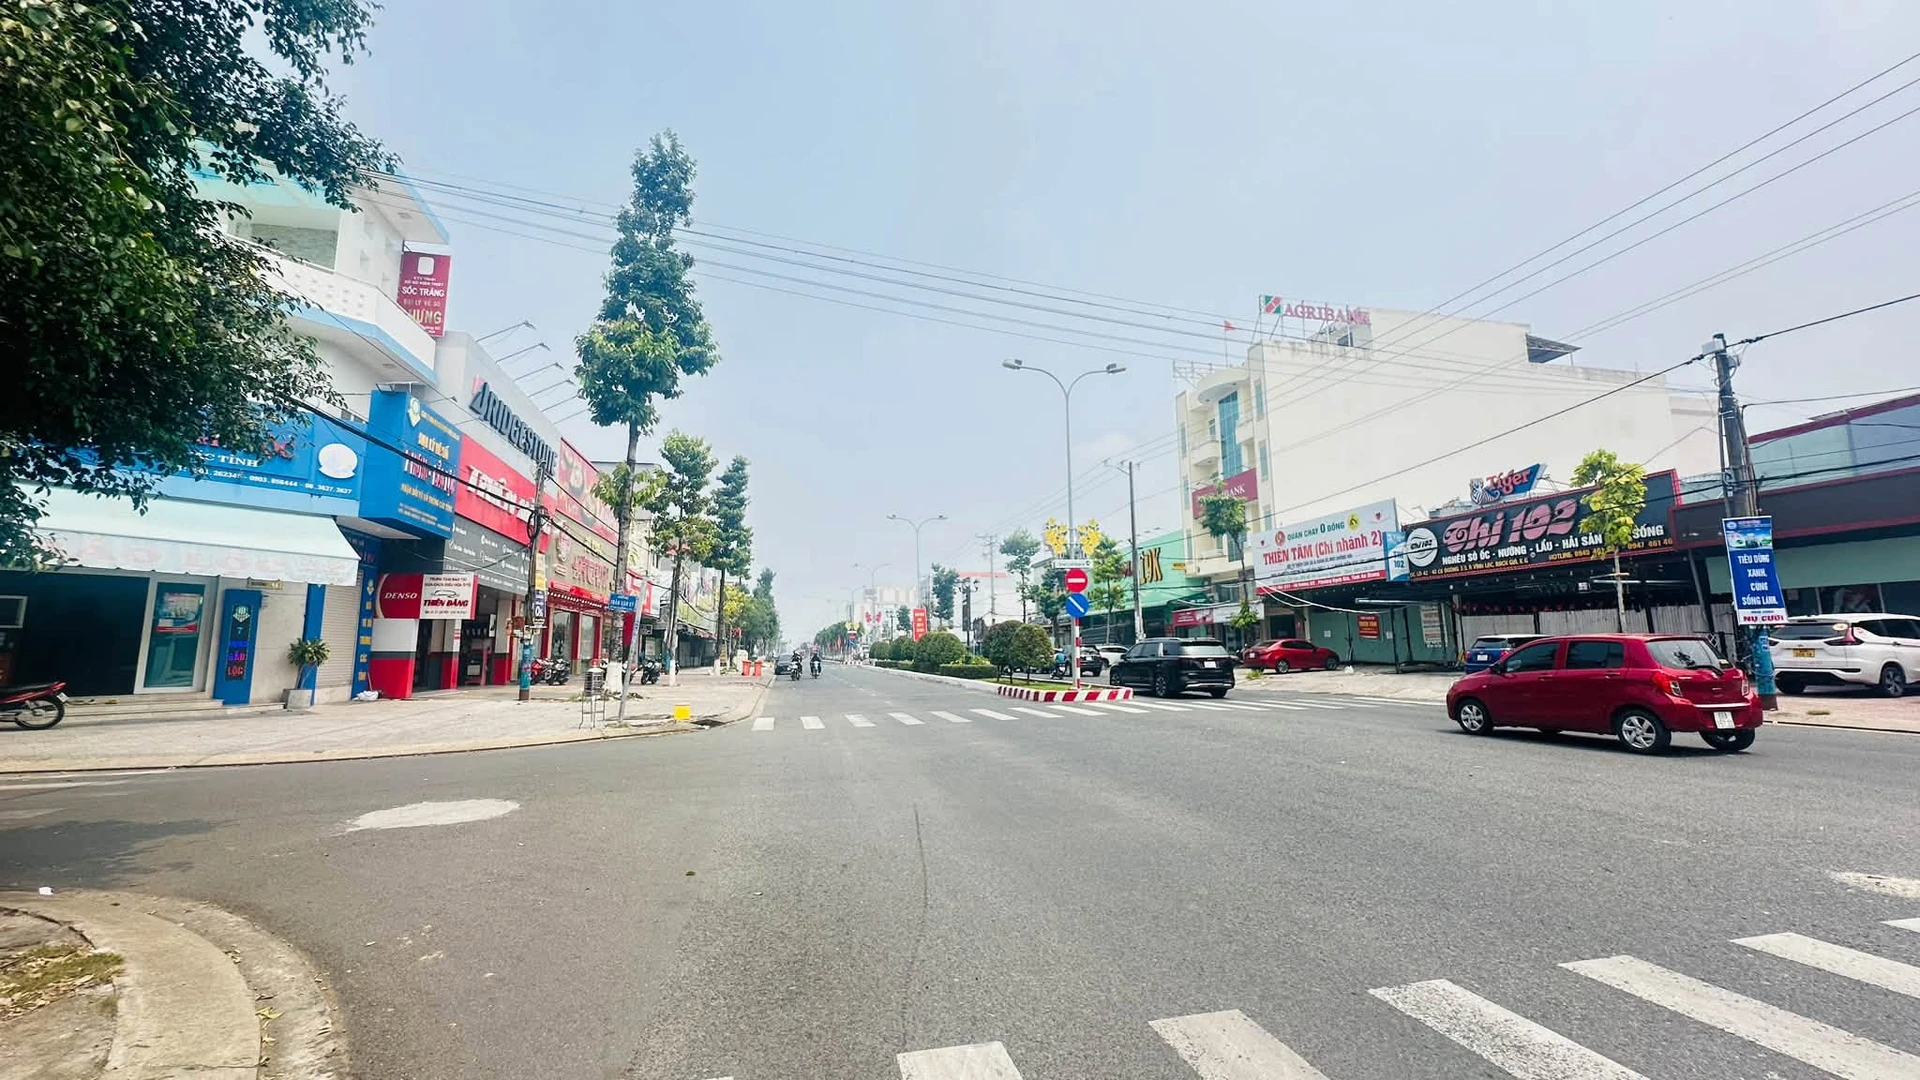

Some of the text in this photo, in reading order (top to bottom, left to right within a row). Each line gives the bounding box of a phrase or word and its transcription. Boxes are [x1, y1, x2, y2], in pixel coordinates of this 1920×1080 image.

[401, 285, 418, 295] SÓC
[1285, 303, 1371, 325] AGRIBANK
[469, 381, 558, 477] BRIDGESTONE
[1486, 468, 1531, 494] Tiger
[1508, 499, 1578, 543] 102
[1304, 528, 1318, 537] CHAY
[1320, 523, 1326, 533] 0
[1263, 547, 1289, 566] THIÊN
[1291, 543, 1313, 560] TÂM
[1315, 540, 1334, 558] (Chi
[1335, 533, 1368, 553] nhánh
[1370, 530, 1383, 547] 2)
[1442, 553, 1467, 565] NGHÊU
[1562, 534, 1579, 549] HẢI
[1581, 532, 1603, 546] SẢN
[1632, 523, 1665, 539] SỐNG
[1393, 560, 1406, 569] 102
[1737, 553, 1753, 565] TIÊU
[1750, 580, 1769, 592] CÙNG
[384, 592, 418, 600] DENSO
[1741, 594, 1761, 606] SỐNG
[423, 598, 445, 607] THIÊN
[1743, 615, 1758, 623] NỤ
